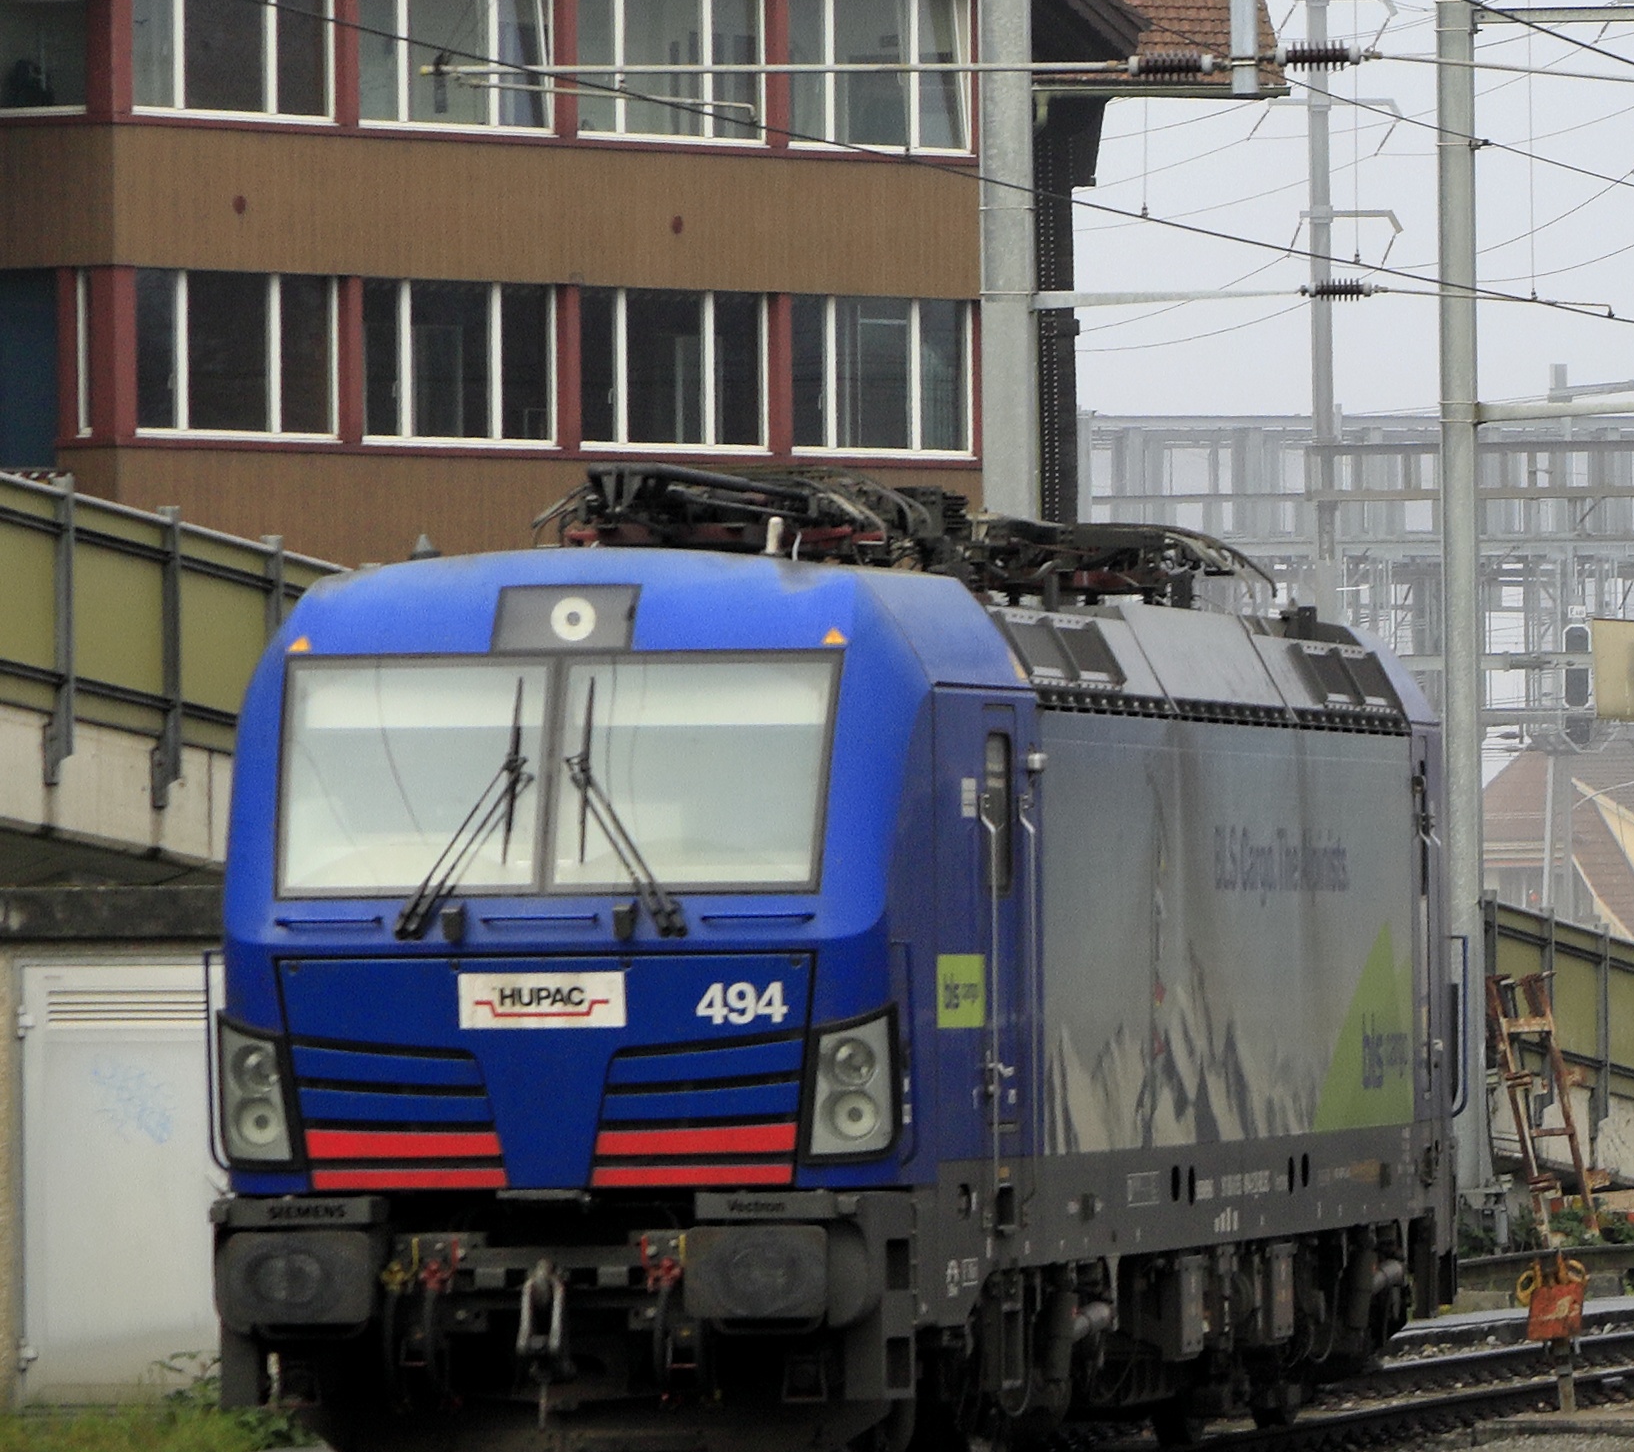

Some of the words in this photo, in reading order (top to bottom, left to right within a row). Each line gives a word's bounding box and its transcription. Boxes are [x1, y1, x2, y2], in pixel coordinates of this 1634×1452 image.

[500, 987, 585, 1007] HUPAC
[696, 980, 789, 1025] 494
[267, 1204, 346, 1220] SIEMENS
[727, 1198, 785, 1213] Vectron
